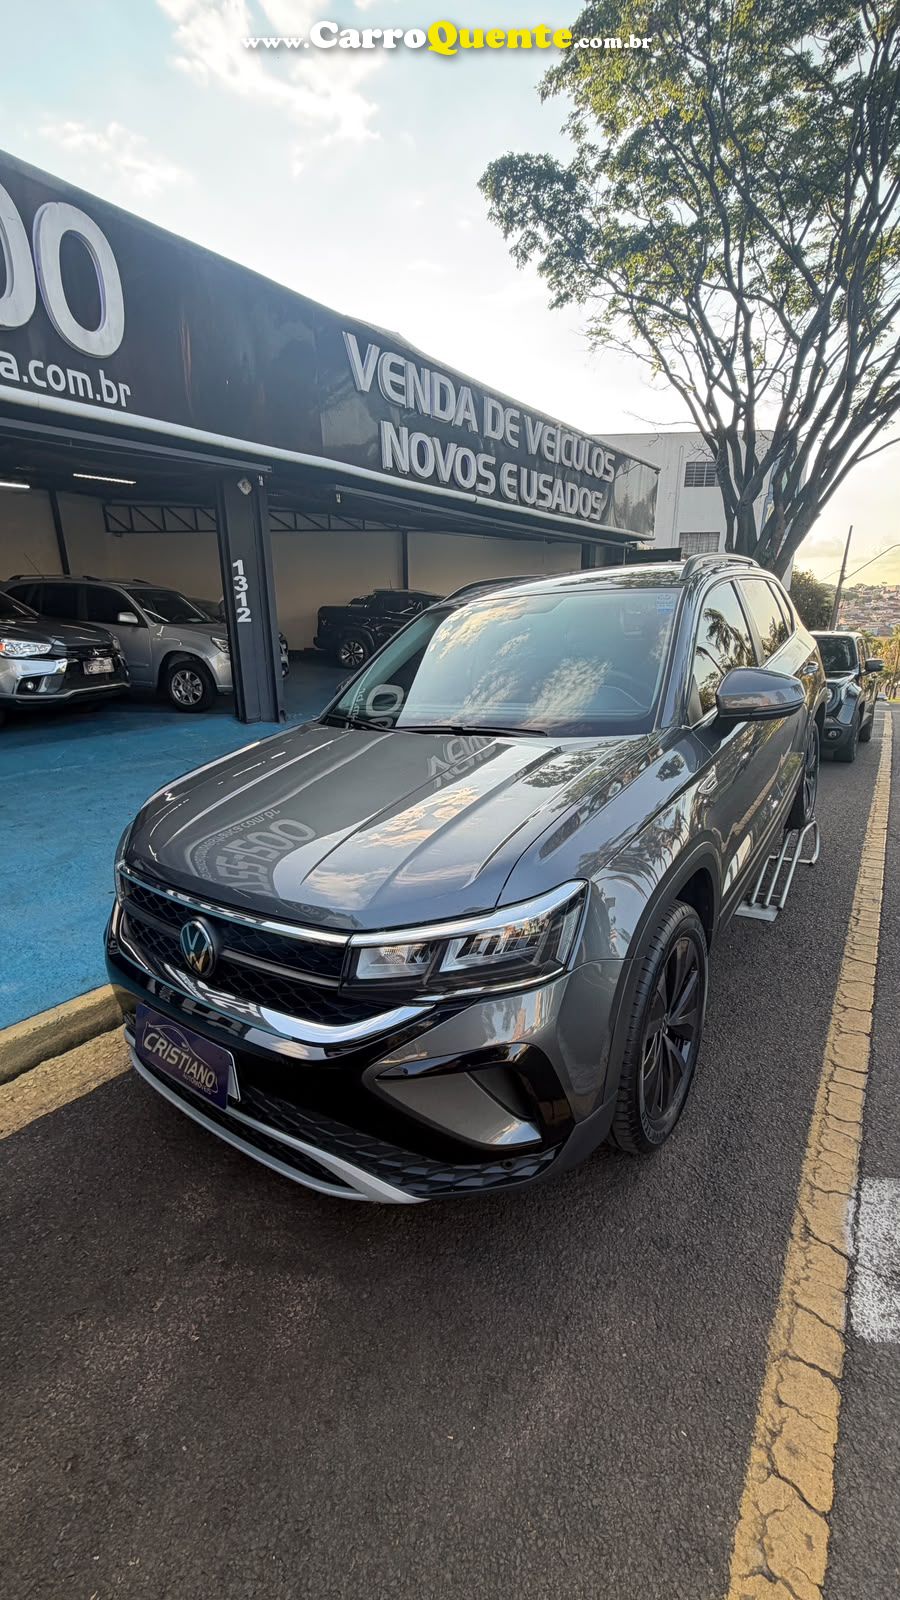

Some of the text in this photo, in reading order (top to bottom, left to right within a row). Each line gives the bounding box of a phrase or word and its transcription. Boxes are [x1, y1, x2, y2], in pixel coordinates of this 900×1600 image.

[0, 350, 131, 407] a.com.br
[342, 331, 479, 433] VENDA
[483, 396, 520, 448] DE
[380, 420, 604, 520] NOVOS E USADOS
[232, 559, 252, 623] 1312
[143, 1032, 216, 1088] CRISTIANO
